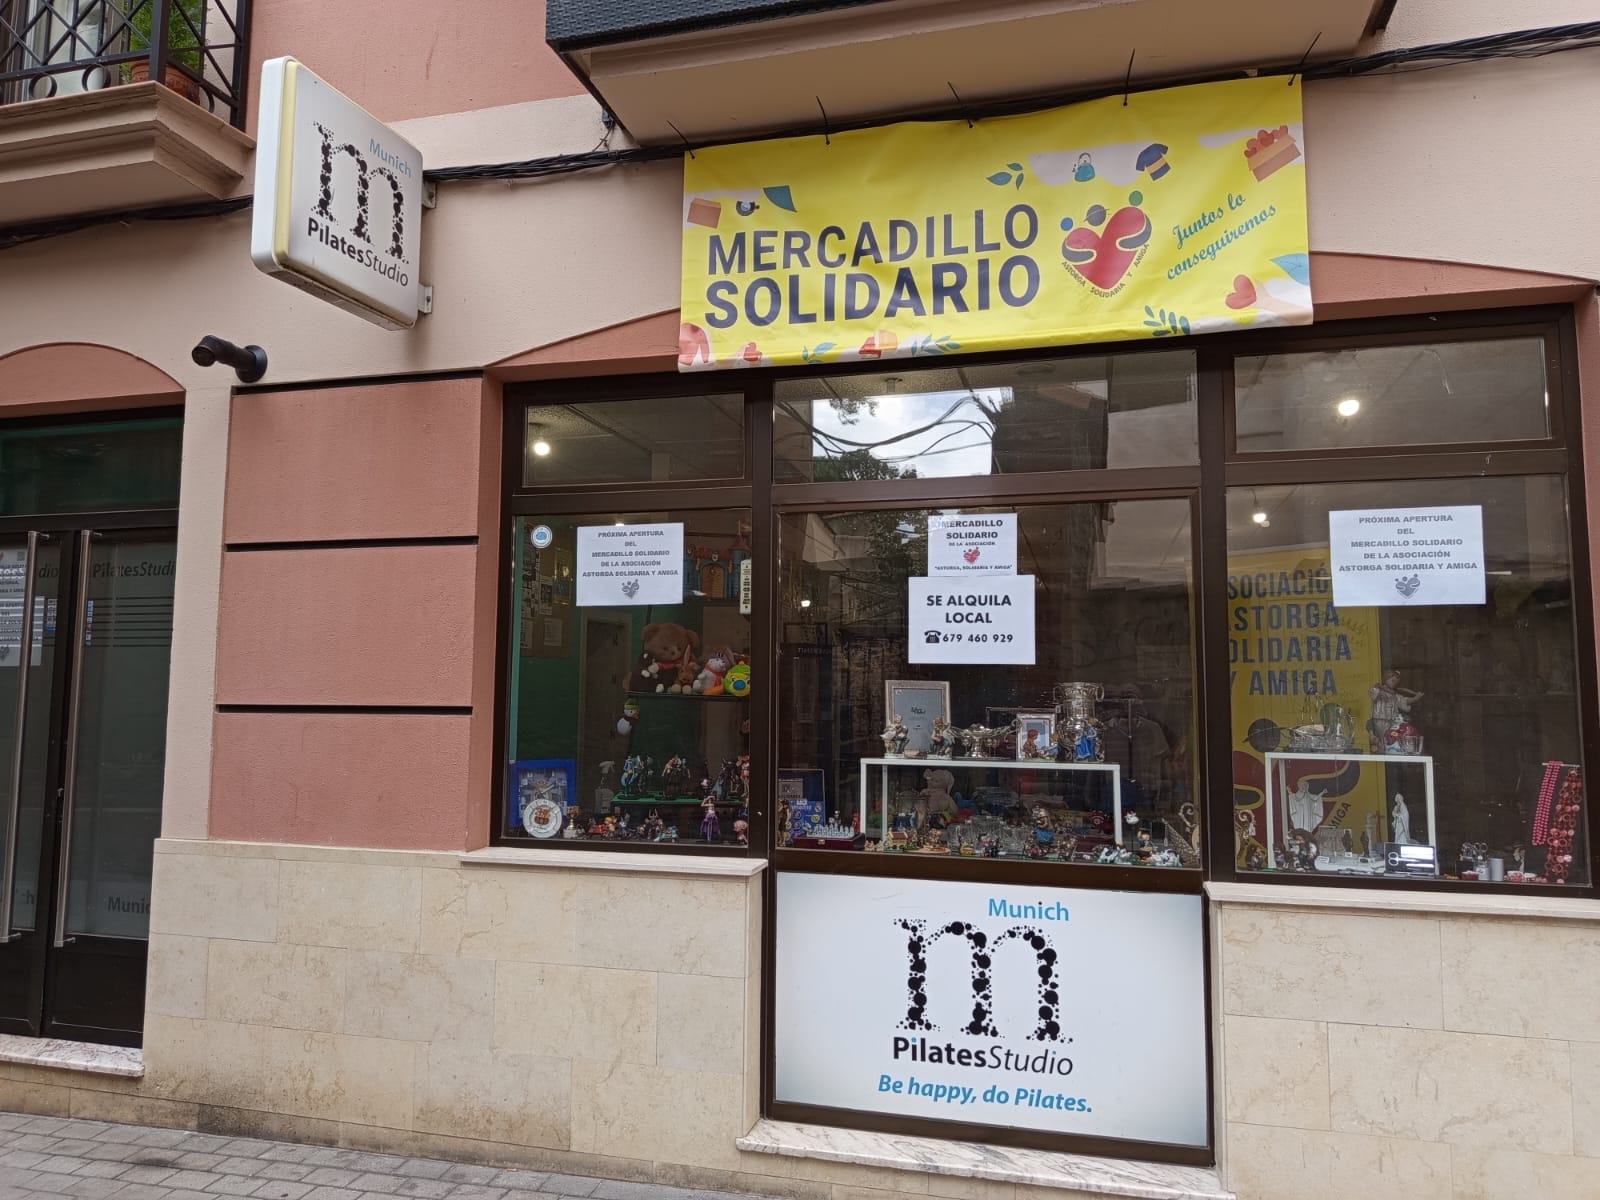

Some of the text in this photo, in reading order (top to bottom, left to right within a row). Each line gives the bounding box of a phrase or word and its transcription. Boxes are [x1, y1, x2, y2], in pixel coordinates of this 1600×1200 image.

[369, 138, 412, 178] Munich
[1172, 192, 1246, 250] Juntos lo
[307, 217, 409, 287] PilatesStudio
[708, 204, 1038, 275] MERCADILLO
[1167, 204, 1276, 280] conseguiremos
[1061, 261, 1086, 287] ASTORGA
[1090, 283, 1126, 298] SOLIDARIA
[1133, 243, 1149, 267] AMIGA
[705, 255, 1040, 328] SOLIDARIO
[942, 519, 1003, 528] MERCADILLO
[1359, 515, 1453, 524] PRÓXIMA APERTURA
[598, 530, 627, 538] PRÓXIMA
[946, 531, 998, 540] SOLIDARIO
[1351, 538, 1463, 548] MERCADILLO SOLIDARIO
[1339, 564, 1383, 572] ASTORGA
[1385, 563, 1434, 571] SOLIDARIA
[1446, 562, 1477, 570] AMIGA
[1392, 550, 1450, 559] ASOCIACIÓN
[93, 560, 175, 578] PilatesStudi
[1228, 563, 1333, 599] SOCIACIÓ
[926, 594, 1012, 607] SE ALQUILA
[945, 612, 993, 623] LOCAL
[1229, 601, 1339, 632] STORGA
[942, 634, 1013, 643] 679 460 929
[1229, 634, 1352, 664] OLIDARIA
[1249, 669, 1337, 696] AMIGA
[1329, 802, 1351, 829] MIGA
[988, 898, 1069, 921] Munich
[893, 1036, 1073, 1076] PilatesStudio
[878, 1074, 1092, 1113] Be happy, do Pilates.
